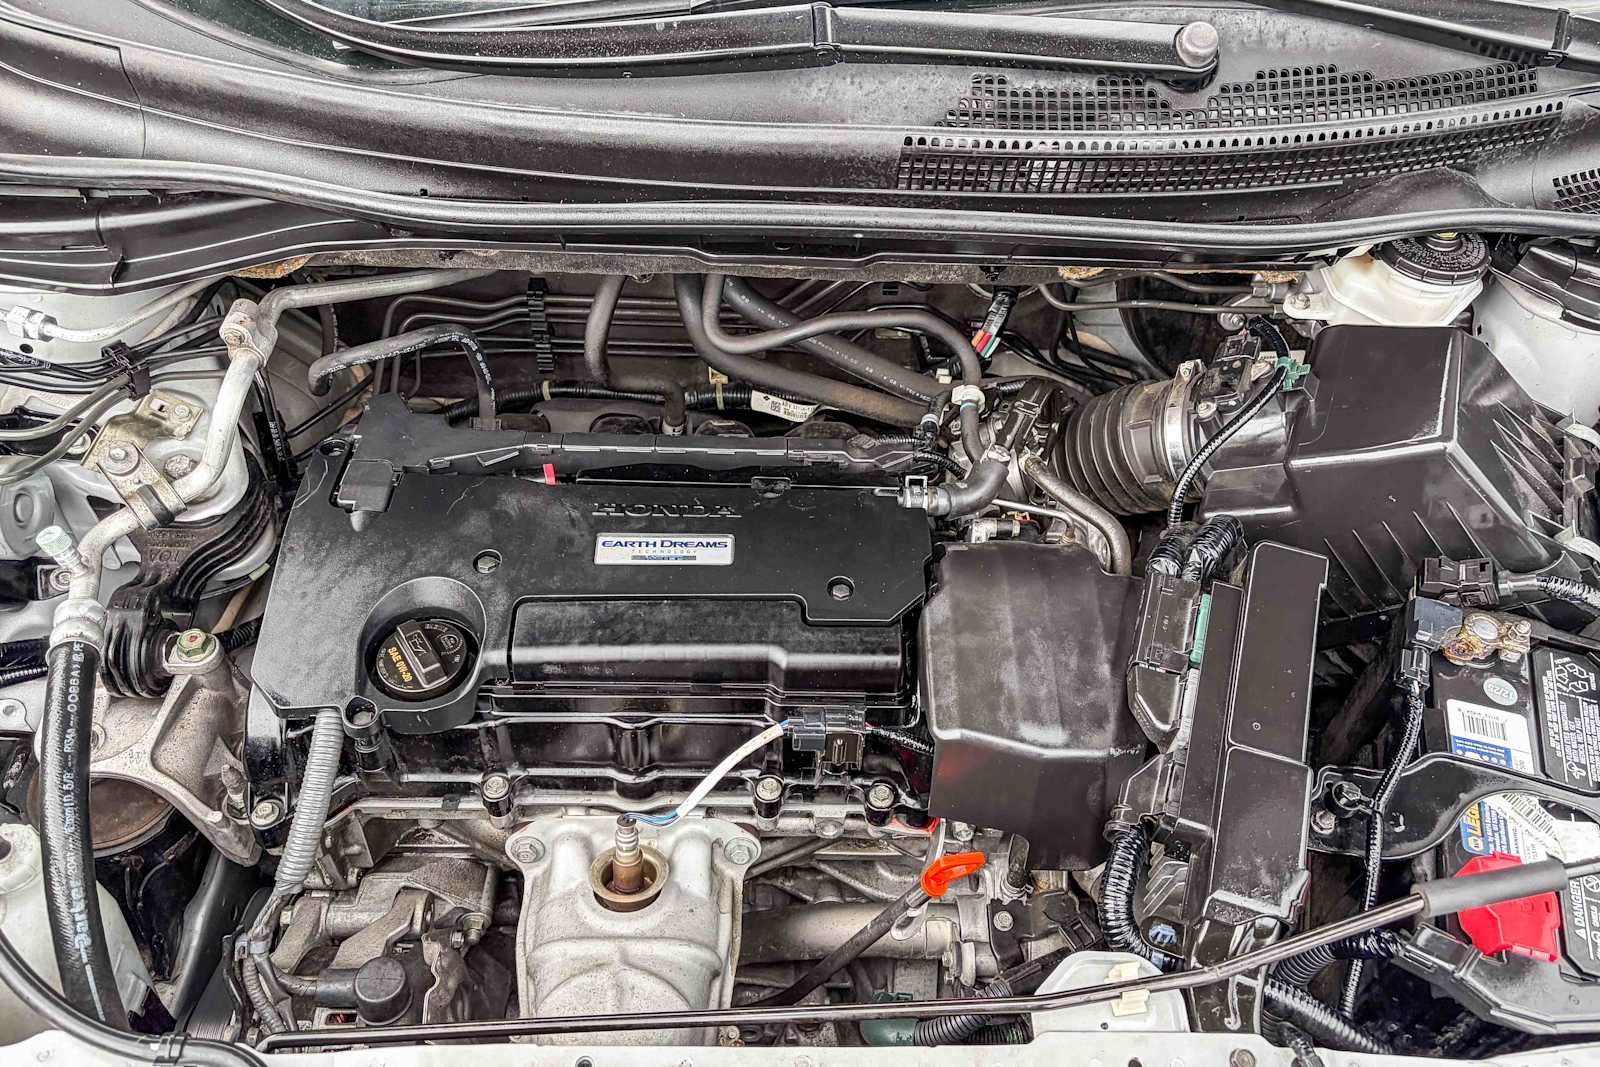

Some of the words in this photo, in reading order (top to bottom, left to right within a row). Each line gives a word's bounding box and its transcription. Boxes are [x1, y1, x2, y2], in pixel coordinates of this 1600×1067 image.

[592, 502, 742, 517] HONDA
[601, 540, 656, 548] EARTH
[660, 539, 728, 548] DREAMS
[388, 646, 402, 663] SAE
